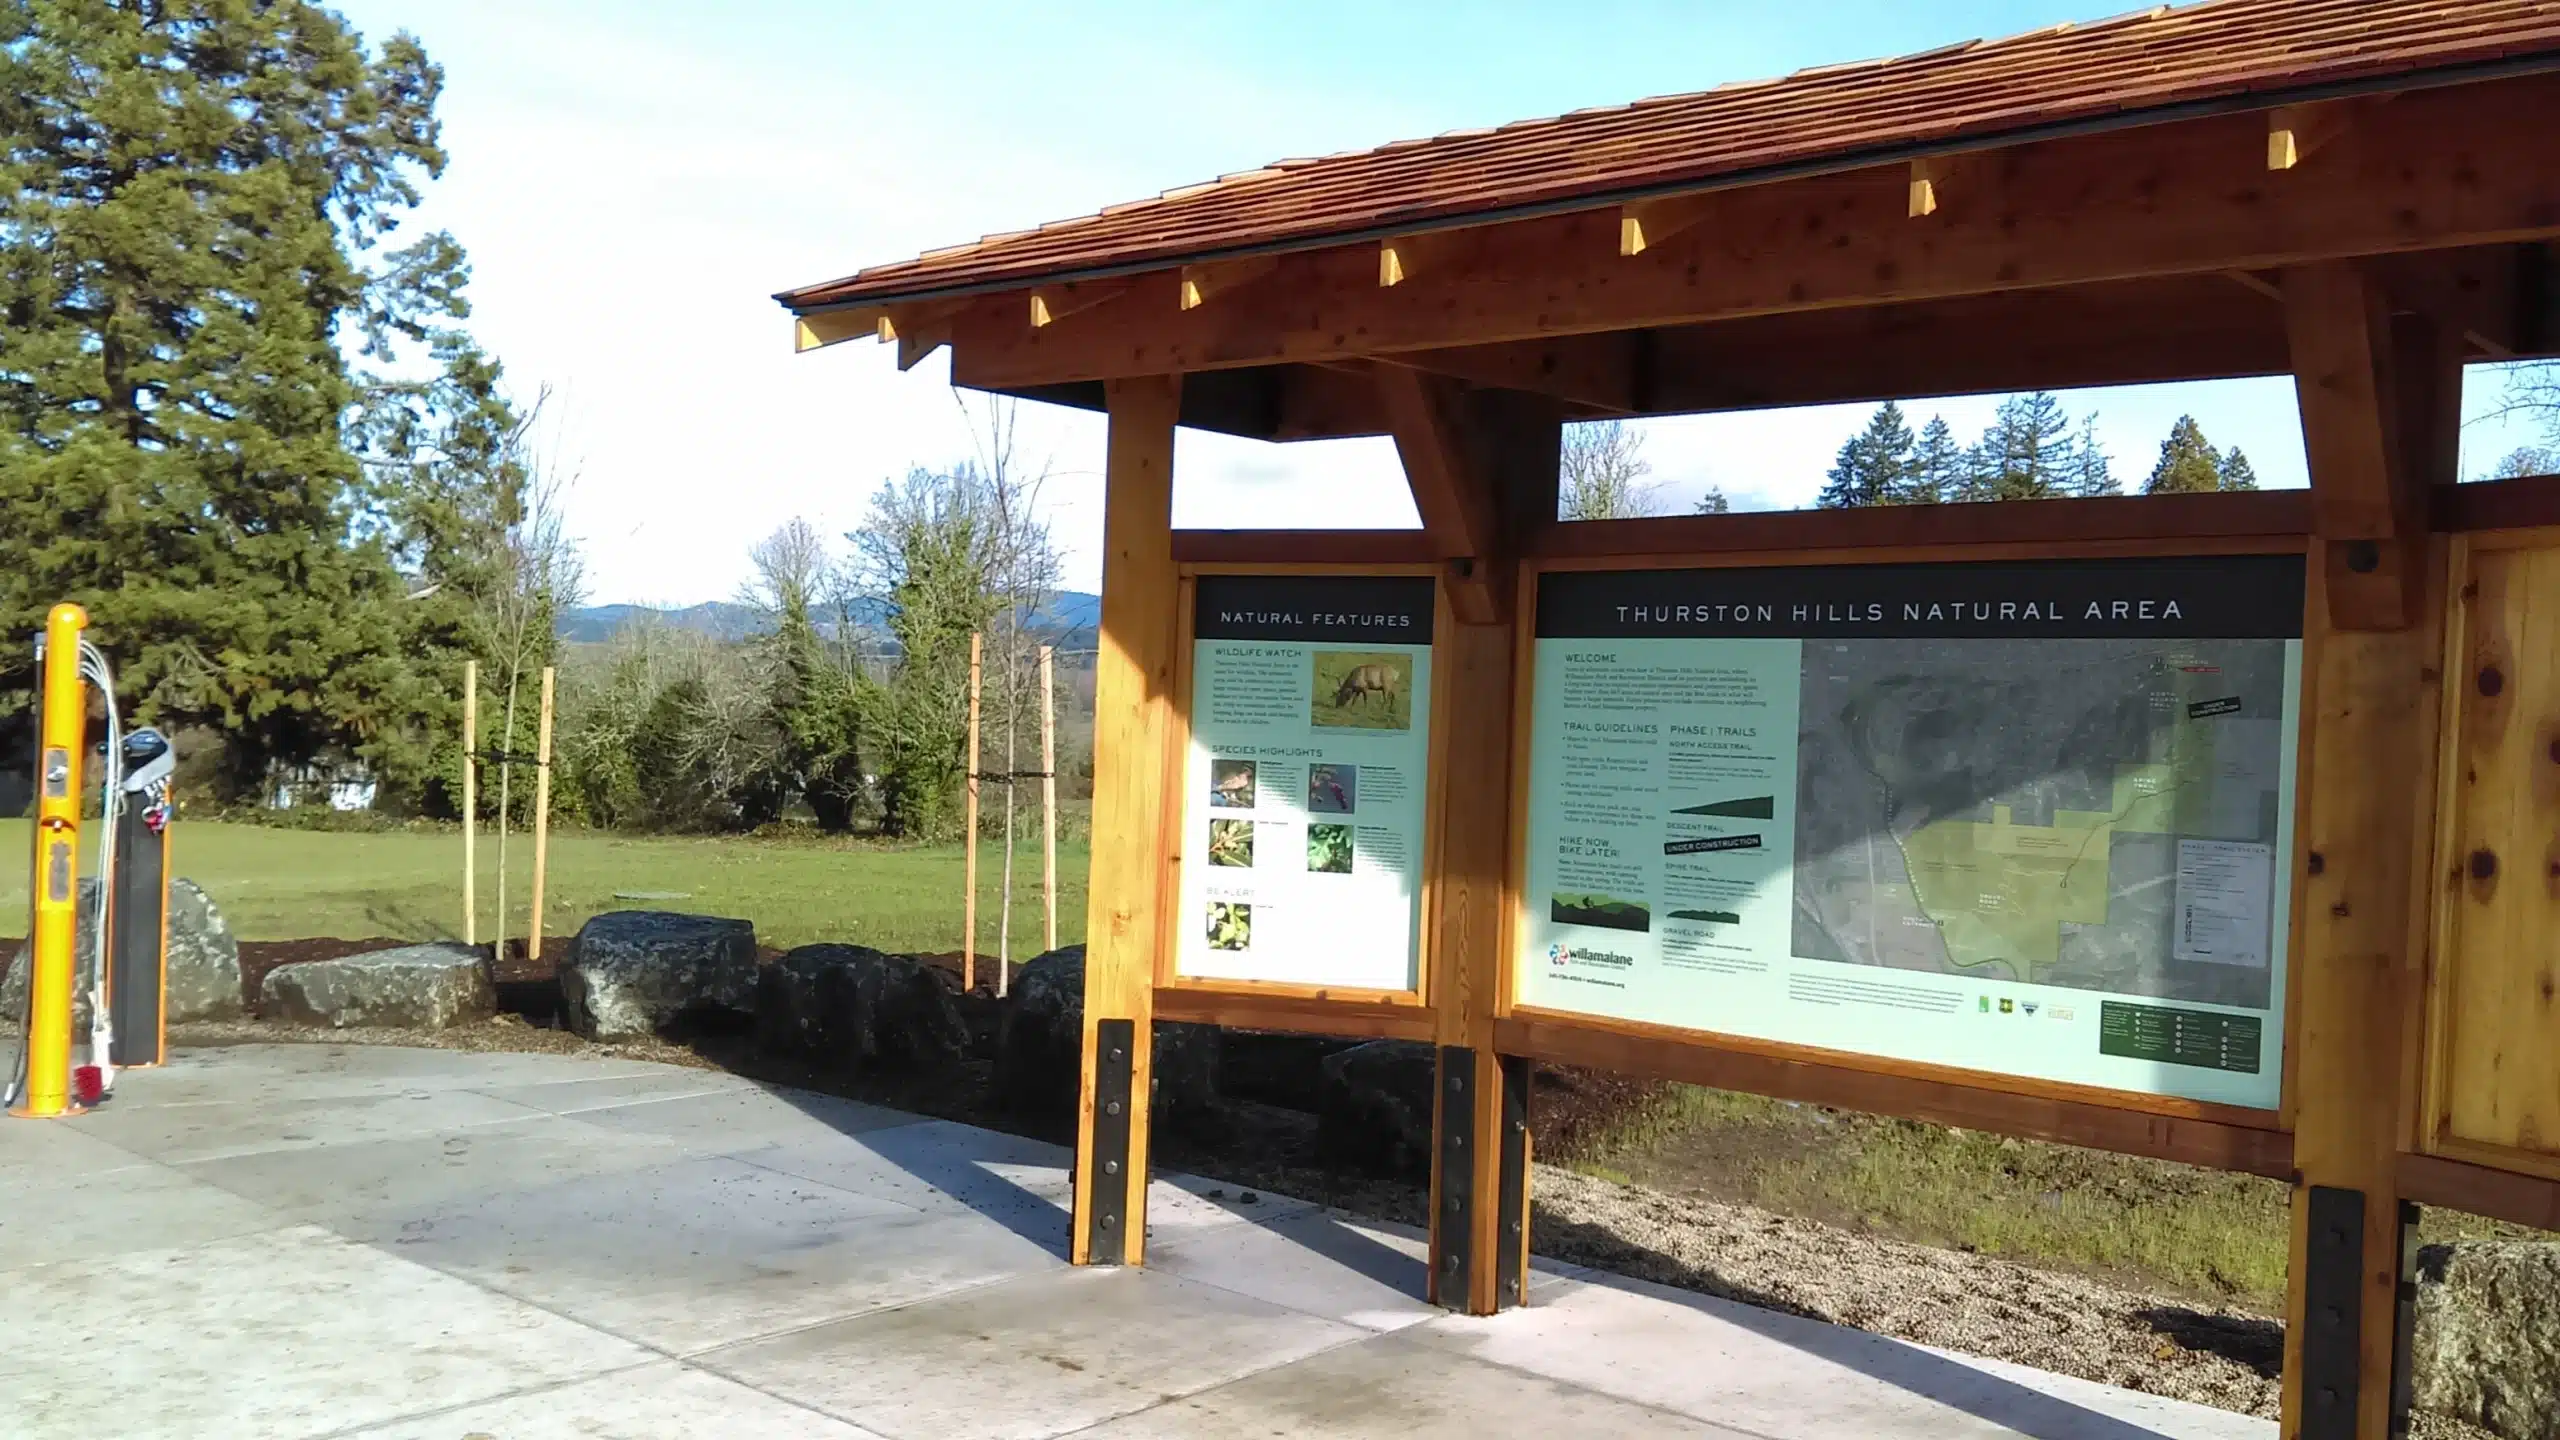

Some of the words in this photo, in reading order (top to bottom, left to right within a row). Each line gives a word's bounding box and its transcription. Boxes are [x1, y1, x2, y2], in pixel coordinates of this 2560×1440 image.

[1616, 604, 1773, 623] THURSTON
[1792, 603, 1883, 622] HILLS
[1903, 602, 2064, 621] NATURAL
[2083, 600, 2183, 620] AREA
[1220, 611, 1304, 625] NATURAL
[1312, 613, 1410, 627] FEATURES
[1215, 647, 1262, 657] WILDLIFE
[1265, 648, 1302, 658] WATCH
[1565, 653, 1617, 663] WELCOME
[1563, 722, 1591, 732] TRAIL
[1594, 723, 1658, 734] GUIDELINES
[1670, 725, 1707, 735] PHASE
[1717, 726, 1757, 738] TRAILS
[1212, 744, 1257, 755] SPECIES
[1260, 747, 1324, 758] HIGHLIGHTS
[1669, 741, 1696, 749] NORTH
[1697, 742, 1728, 750] ACCESS
[1730, 743, 1752, 751] TRAIL
[1666, 822, 1701, 831] DESCENT
[1704, 824, 1724, 833] TRAIL
[1559, 836, 1583, 846] HIKE
[1666, 844, 1695, 853] UNDER
[1695, 837, 1759, 850] CONSTRUCTION
[1559, 845, 1581, 856] BIKE
[1585, 848, 1620, 858] LATER!
[1694, 930, 1716, 939] ROAD
[1569, 948, 1633, 966] willamalane
